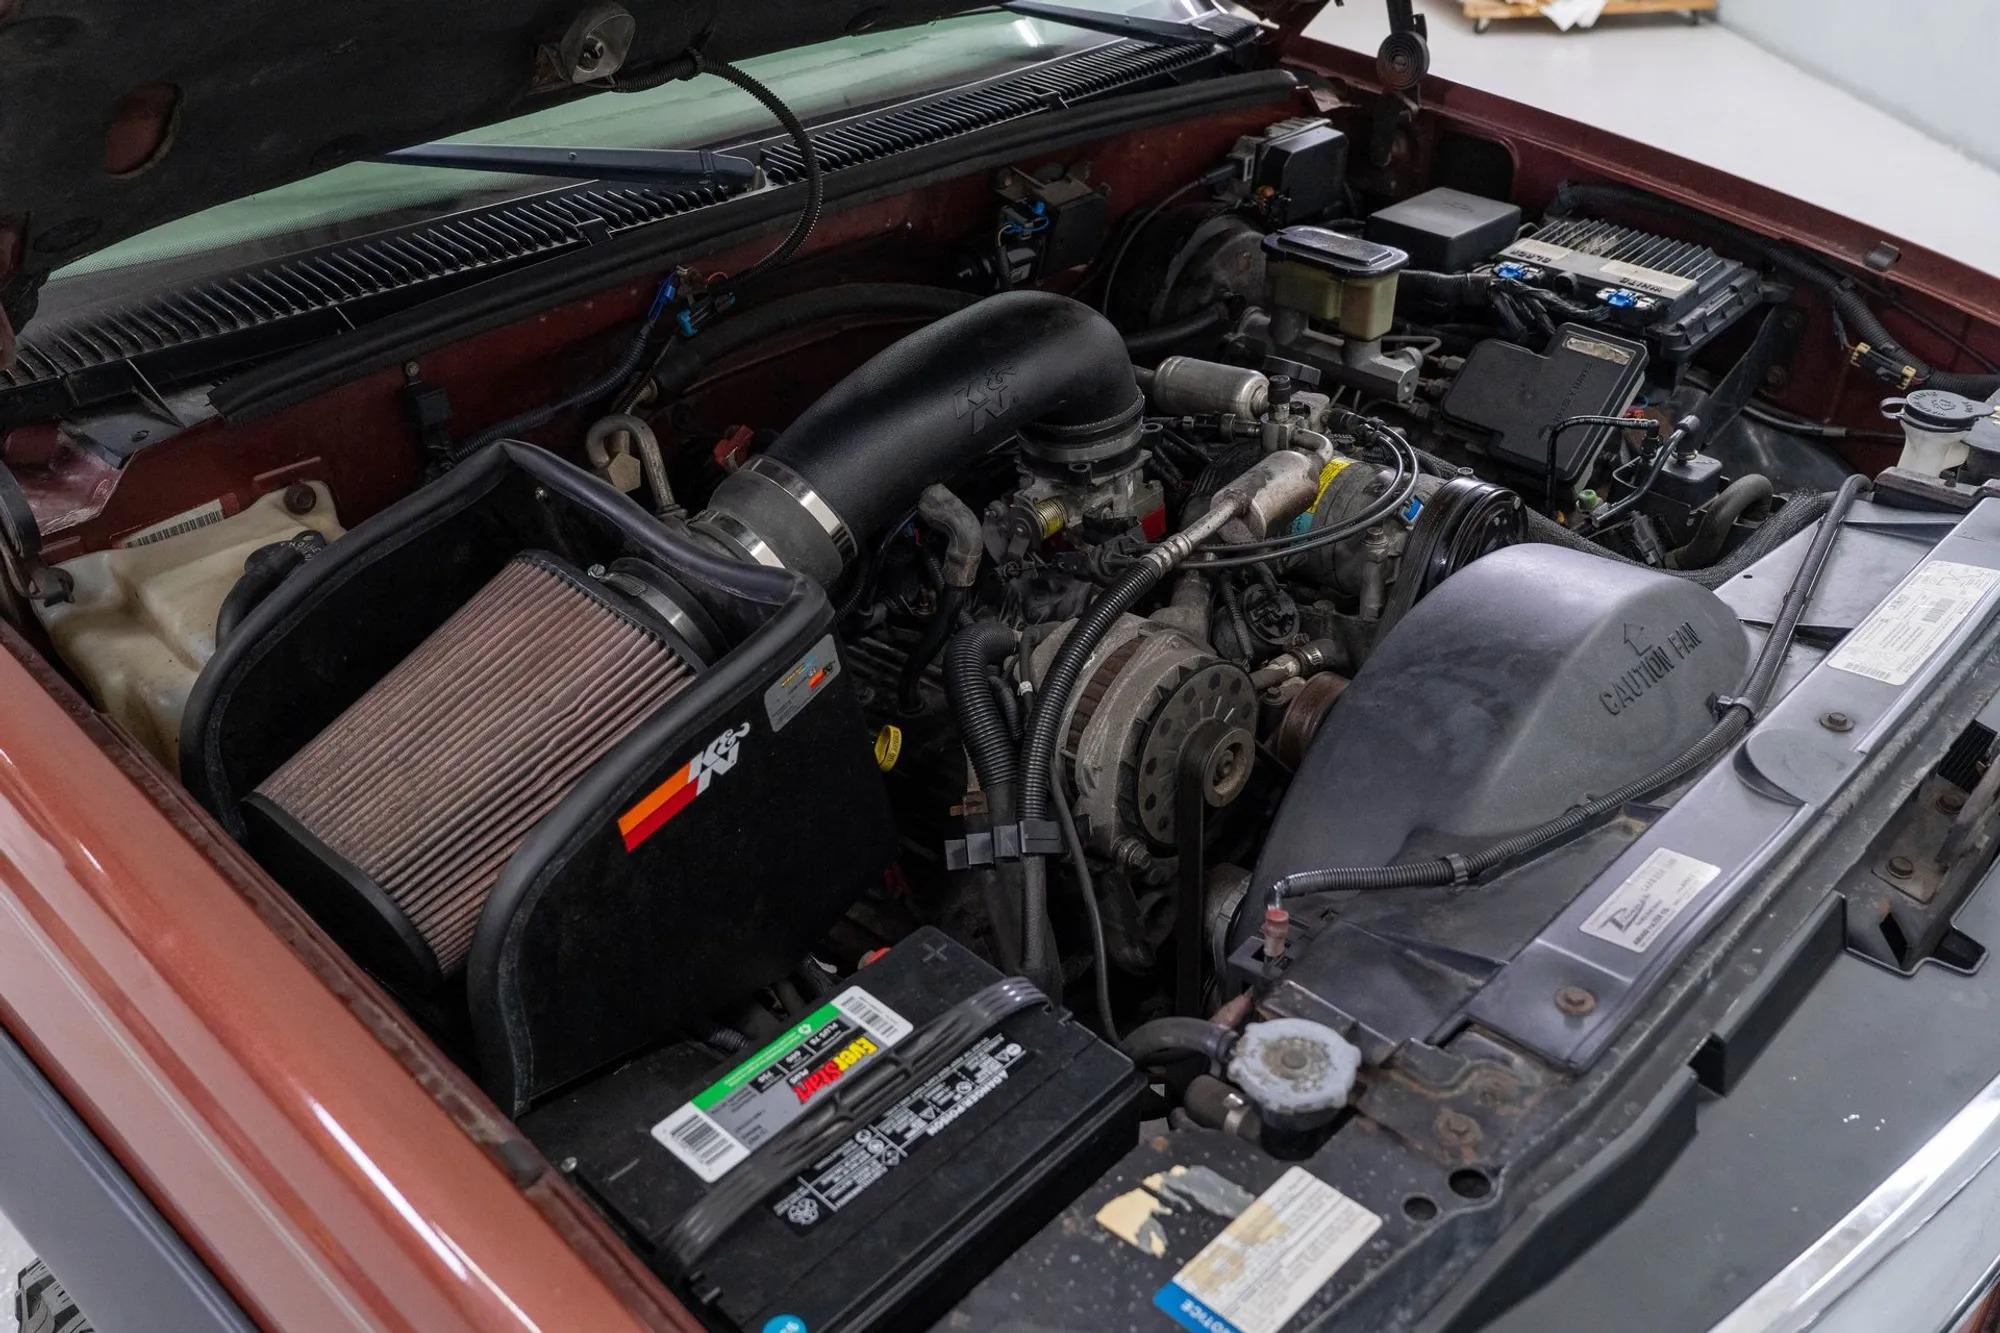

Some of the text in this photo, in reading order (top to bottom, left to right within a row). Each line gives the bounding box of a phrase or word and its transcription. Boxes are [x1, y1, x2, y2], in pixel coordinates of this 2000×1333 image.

[1619, 277, 1663, 293] WHITE
[1599, 621, 1702, 716] CAUTION FAN
[687, 721, 749, 796] K&N
[788, 1067, 810, 1084] PLUS
[791, 1035, 879, 1104] EverStart
